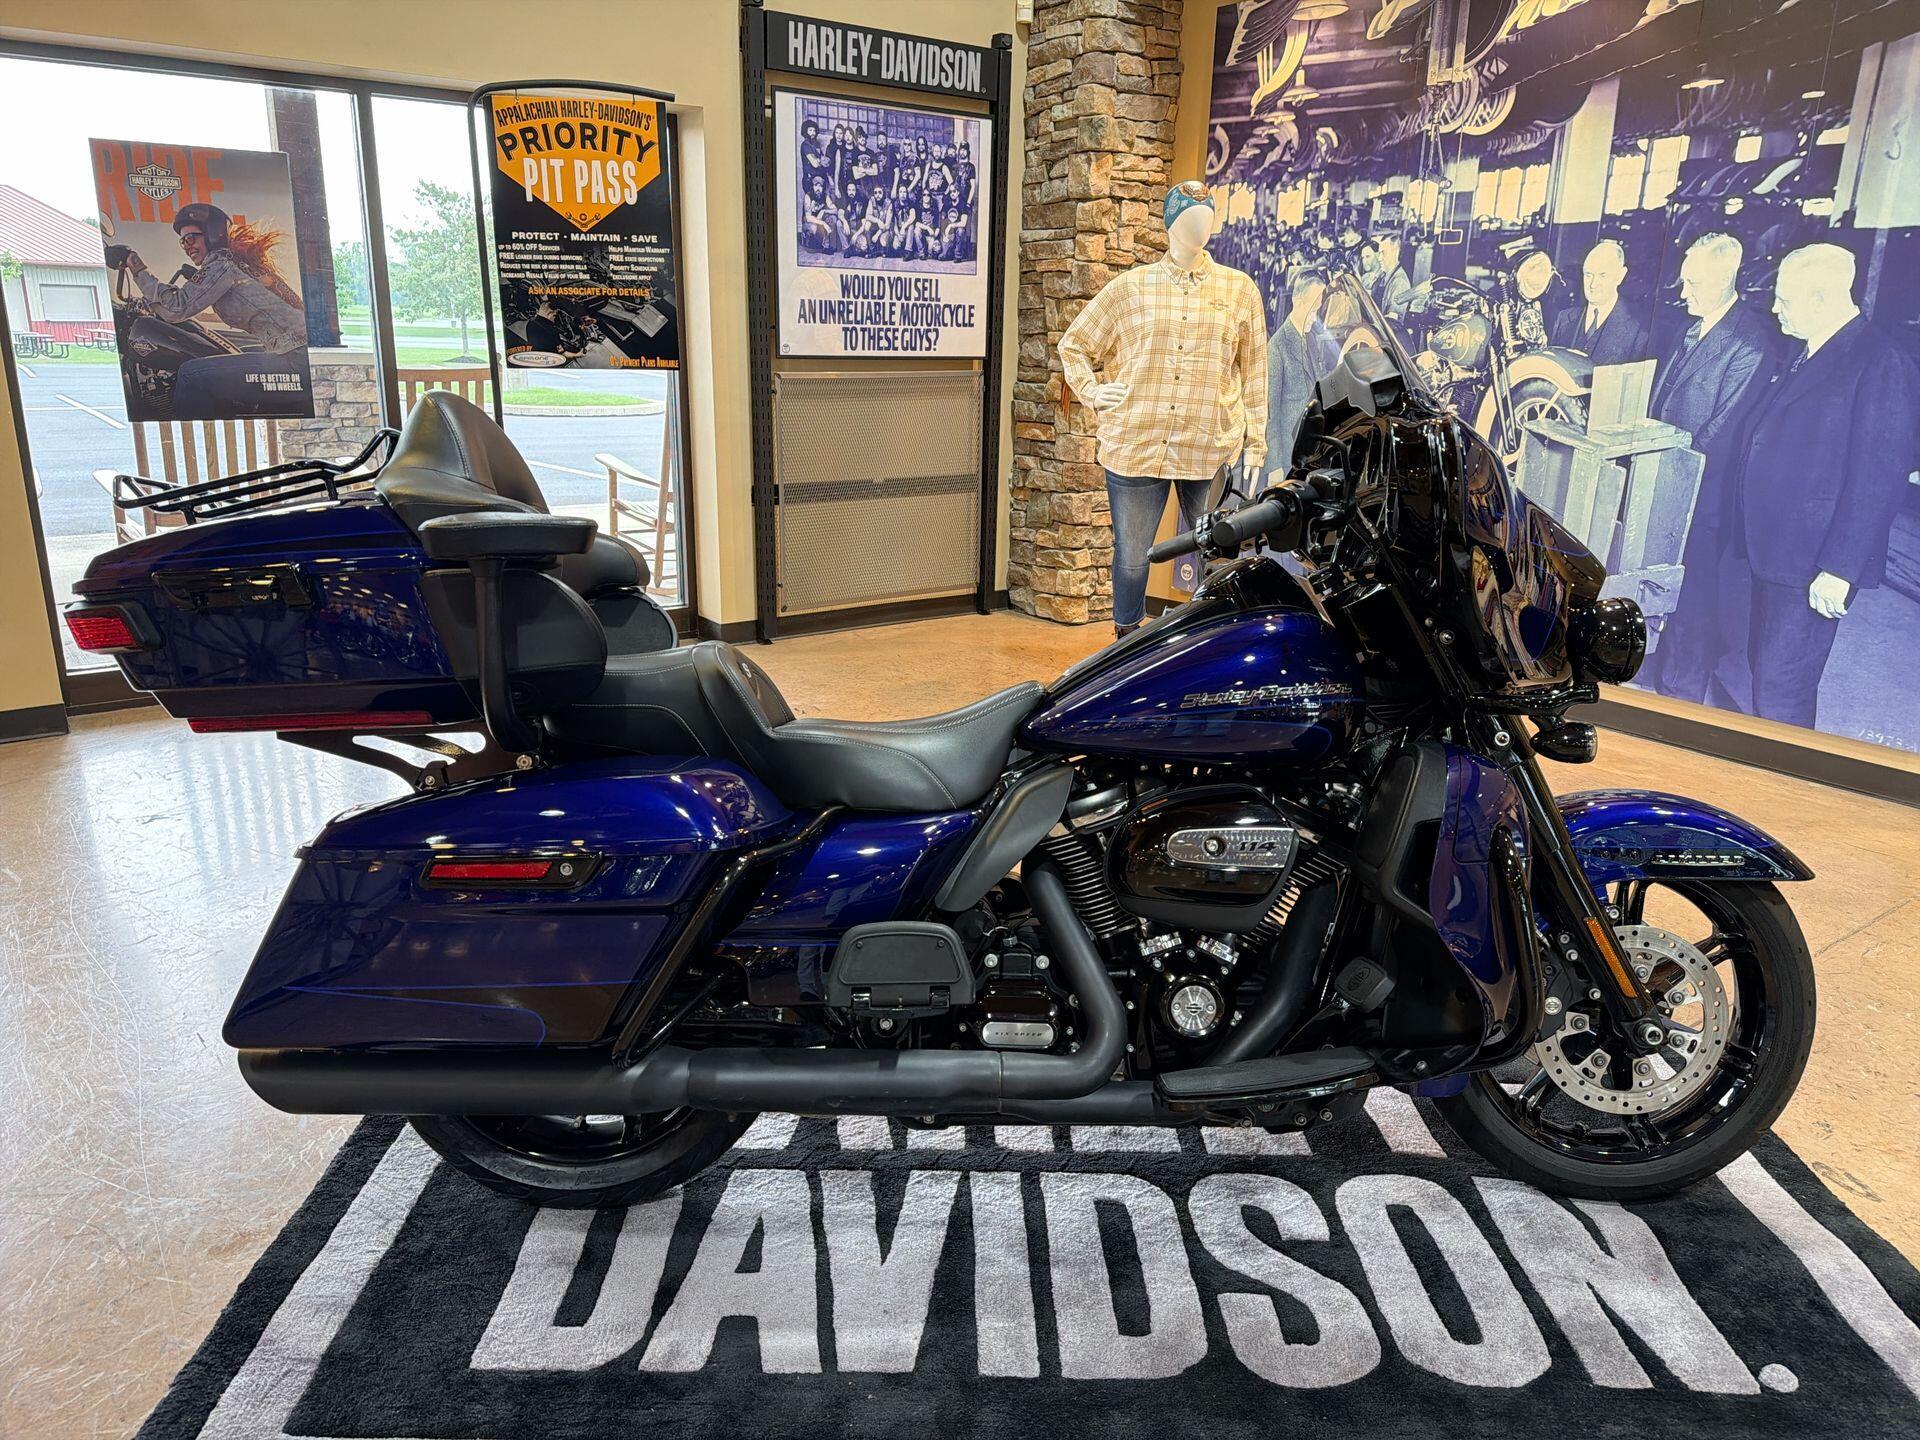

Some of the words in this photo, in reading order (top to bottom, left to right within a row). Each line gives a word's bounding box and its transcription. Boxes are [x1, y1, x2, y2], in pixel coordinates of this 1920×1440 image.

[788, 20, 983, 93] HARLEY-DAVIDSON
[496, 103, 559, 127] APPALACHIAN
[560, 100, 651, 131] HARLEY-DAVIDSON'S
[497, 122, 656, 163] PRIORITY
[523, 157, 564, 202] PIT
[573, 160, 638, 205] PASS
[512, 231, 560, 240] PROTECT
[570, 233, 620, 242] MAINTAIN
[631, 235, 658, 243] SAVE
[525, 243, 537, 251] OFF
[528, 287, 544, 295] ASK
[545, 287, 557, 295] AN
[558, 287, 601, 296] ASSOCIATE
[602, 288, 618, 296] FOR
[619, 288, 651, 297] DETAILS
[840, 274, 886, 301] WOULD
[887, 276, 912, 301] YOU
[913, 278, 941, 302] SELL
[798, 299, 819, 325] AN
[819, 300, 896, 327] UNRELIABLE
[901, 303, 975, 329] MOTORCYCLE
[842, 326, 859, 350] TO
[860, 326, 899, 351] THESE
[901, 328, 939, 352] GUYS?
[245, 373, 260, 382] LIFE
[260, 373, 267, 382] IS
[267, 374, 290, 382] BETTER
[291, 374, 300, 382] ON
[262, 382, 277, 391] TWO
[1239, 841, 1276, 852] 114
